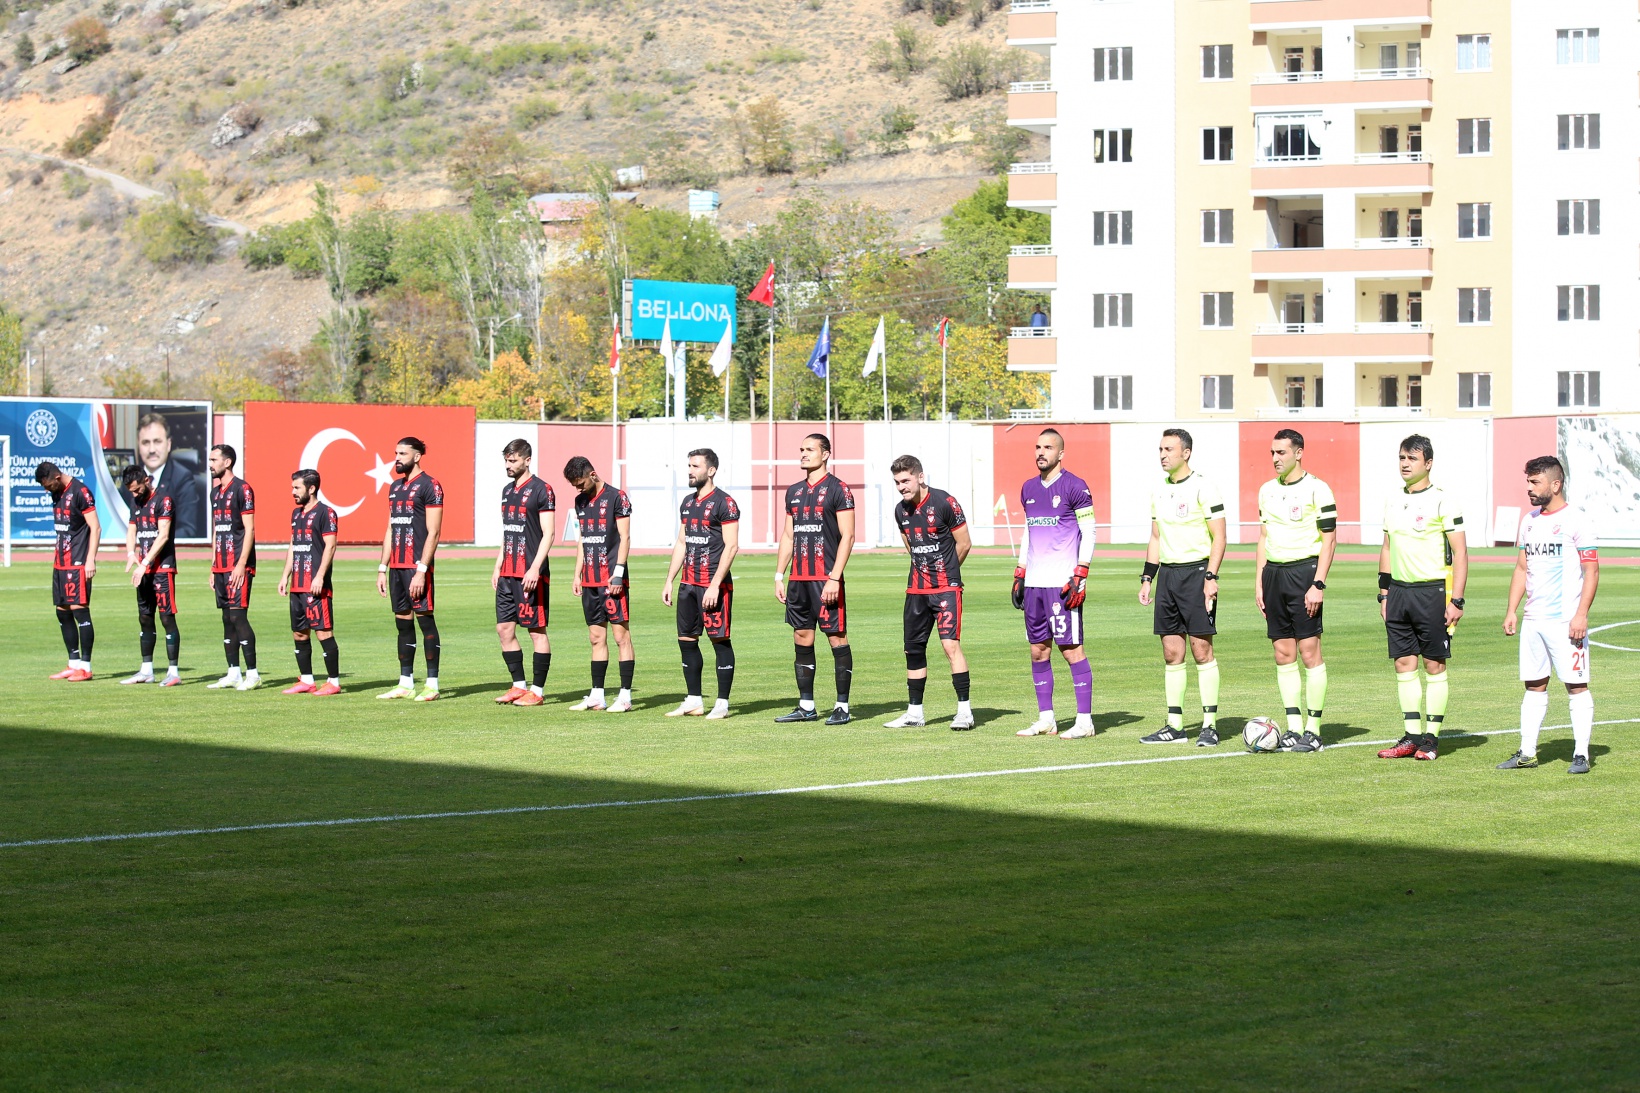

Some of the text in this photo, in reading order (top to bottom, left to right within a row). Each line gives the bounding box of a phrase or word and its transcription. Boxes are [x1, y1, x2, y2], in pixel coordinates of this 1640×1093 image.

[637, 299, 731, 322] BELLONA
[10, 455, 28, 466] TÜM
[15, 495, 40, 505] Ercan
[1525, 543, 1562, 557] OLKART
[64, 582, 76, 597] 12
[156, 592, 167, 607] 21
[605, 599, 617, 614] 9
[306, 605, 320, 621] 41
[519, 603, 534, 618] 24
[819, 606, 830, 621] 4
[703, 612, 722, 629] 53
[937, 611, 954, 629] 22
[1050, 615, 1067, 633] 13
[1572, 651, 1586, 671] 21
